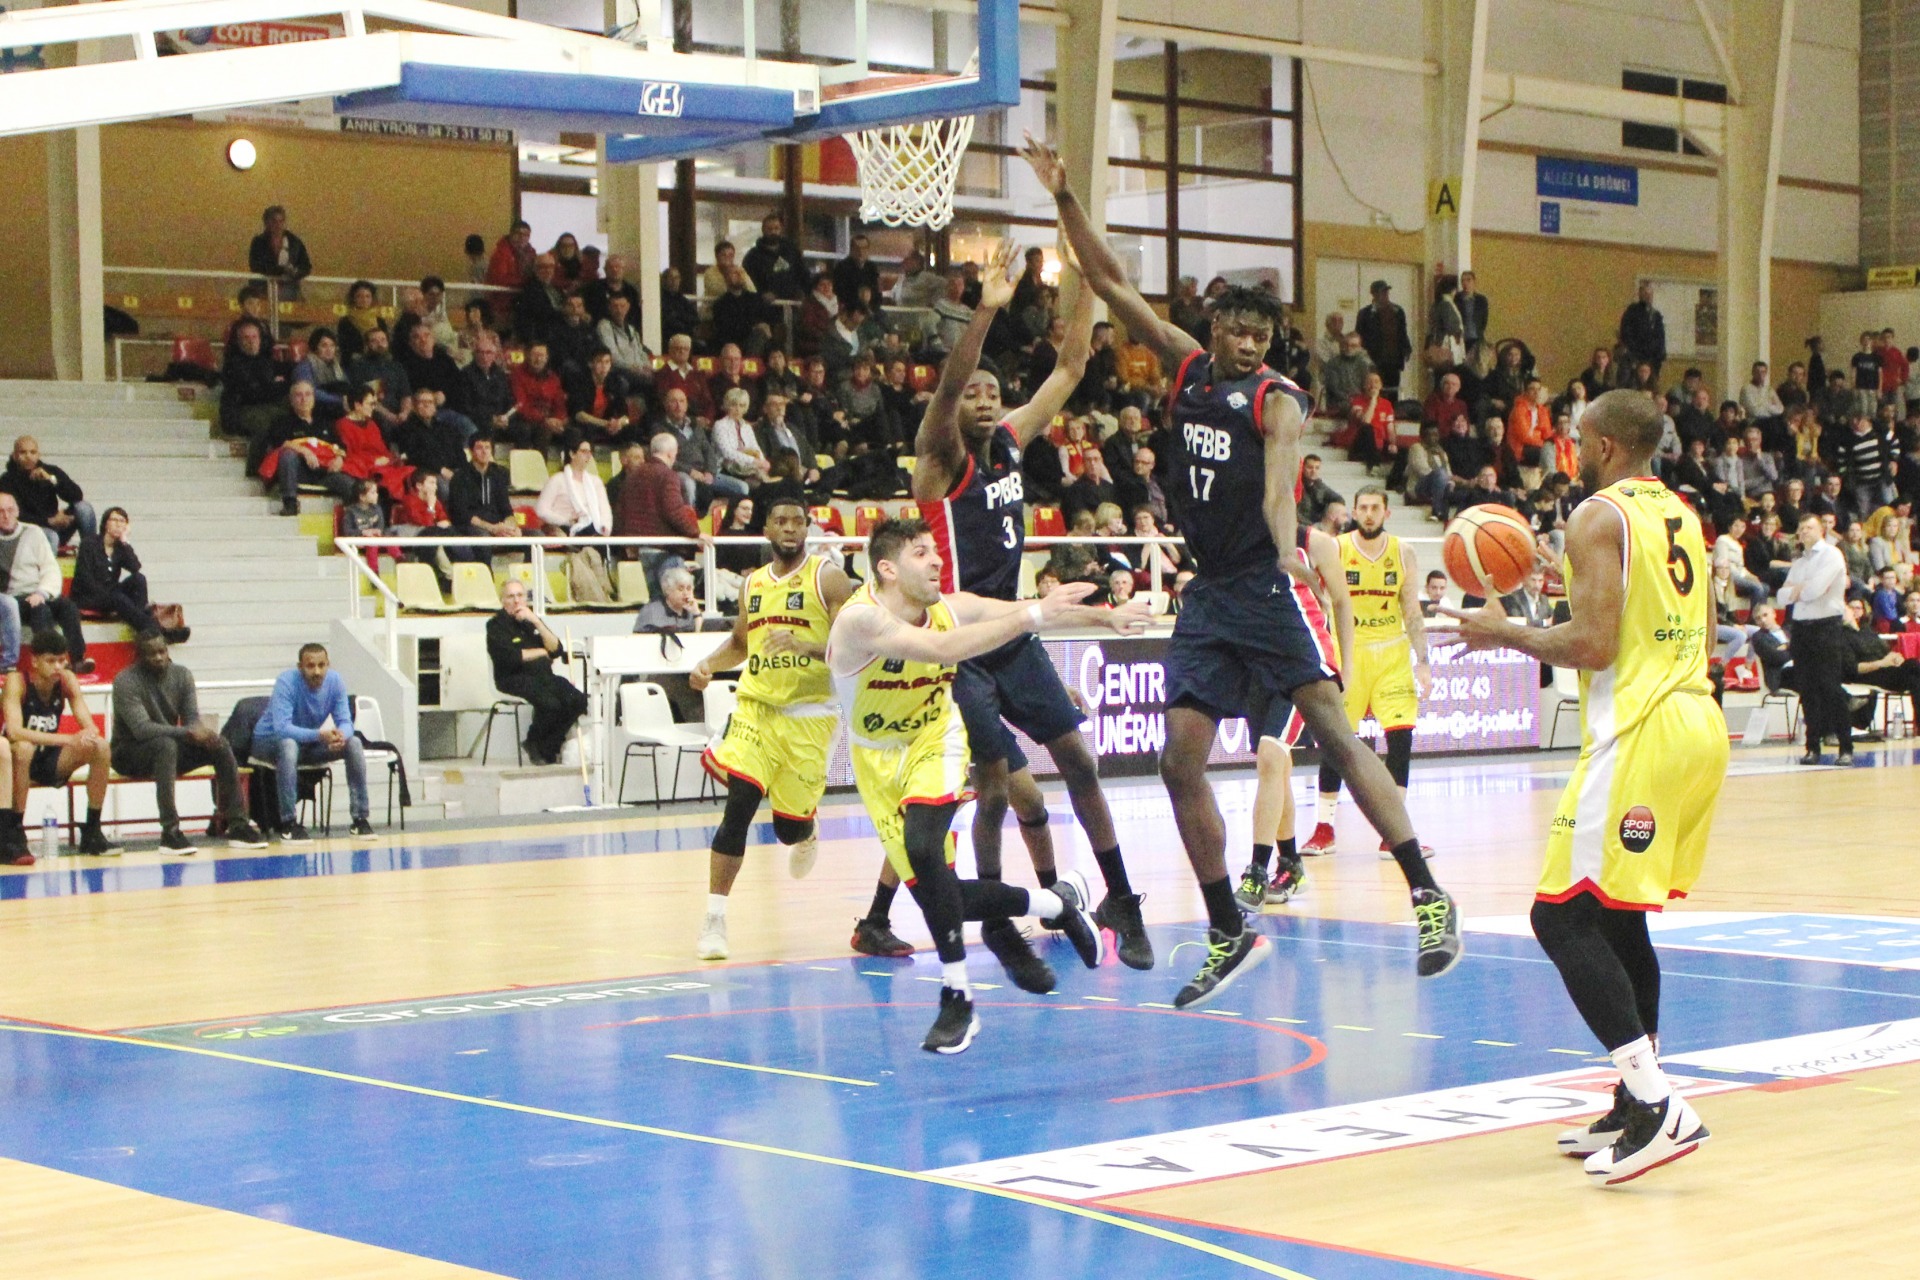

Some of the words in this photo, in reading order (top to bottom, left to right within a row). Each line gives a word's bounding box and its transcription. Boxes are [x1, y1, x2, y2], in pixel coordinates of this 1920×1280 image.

[643, 82, 680, 116] GES
[1576, 173, 1590, 188] LA
[1435, 183, 1455, 214] A
[1183, 422, 1232, 461] PFBB
[1189, 465, 1216, 501] 17
[1002, 515, 1018, 549] 3
[1664, 516, 1695, 598] 5
[1428, 676, 1448, 701] 23
[1450, 676, 1470, 701] 02
[1623, 819, 1654, 831] SPORT
[322, 980, 711, 1023] Groupama
